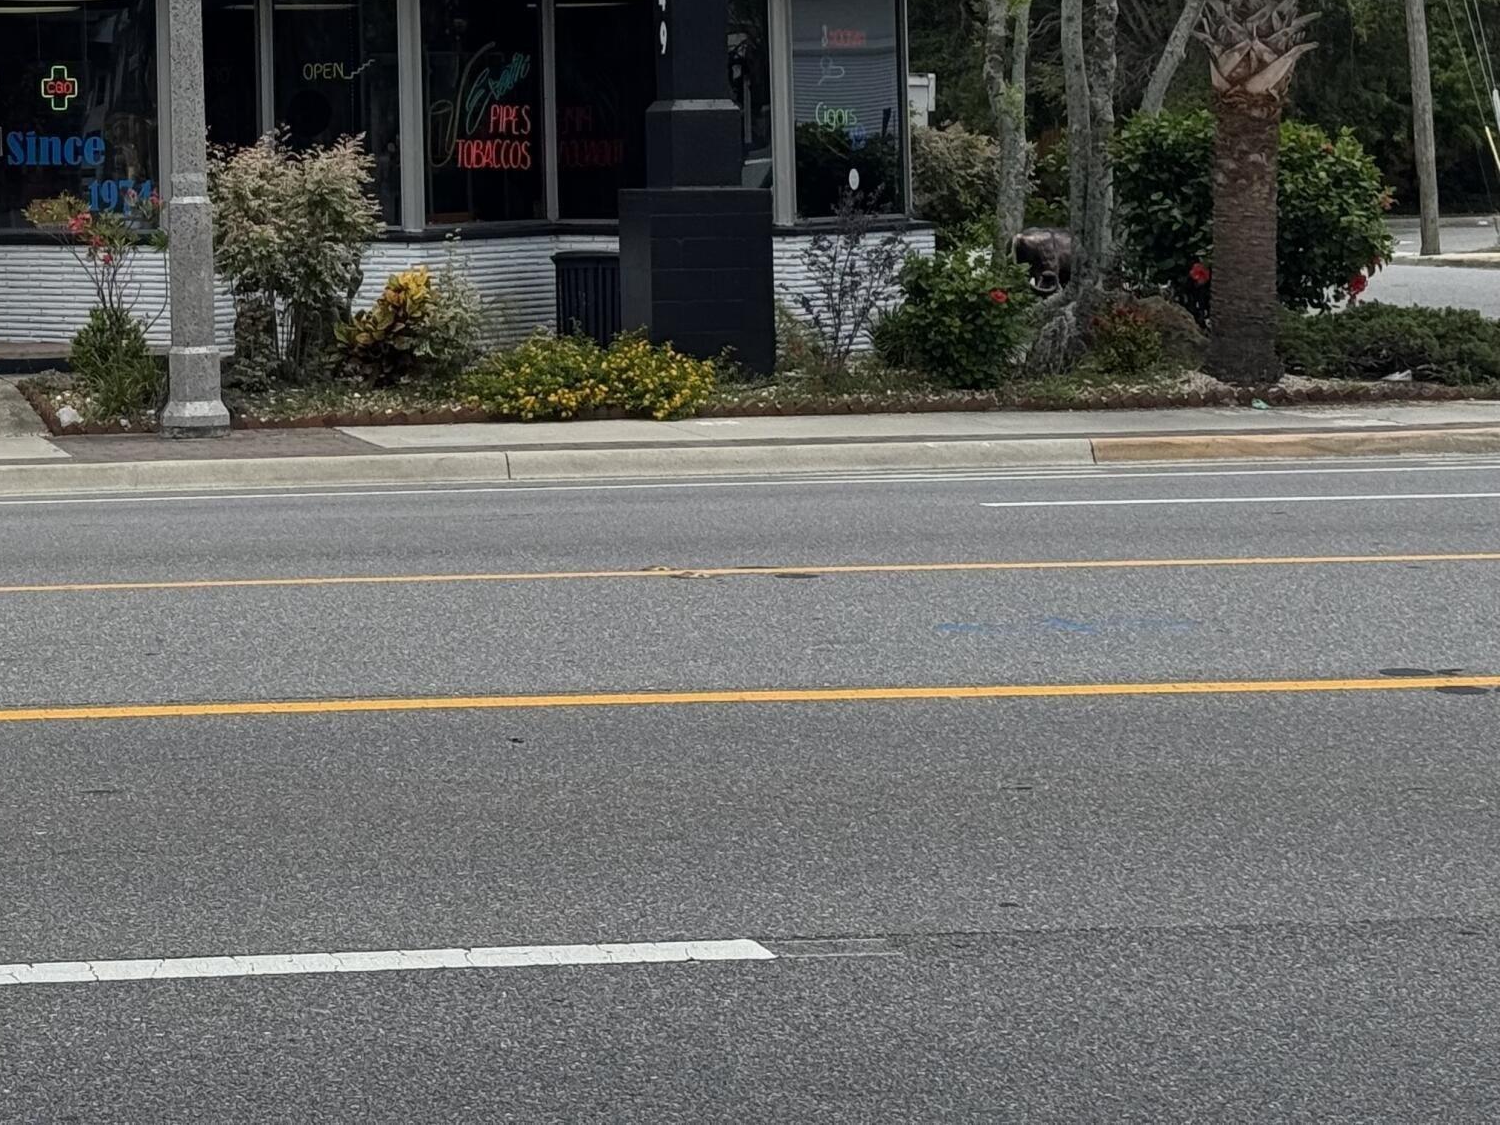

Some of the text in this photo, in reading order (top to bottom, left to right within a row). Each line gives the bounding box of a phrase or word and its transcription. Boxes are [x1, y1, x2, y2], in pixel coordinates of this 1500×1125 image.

[302, 62, 346, 81] OPEN
[46, 81, 73, 94] CBD
[489, 104, 531, 135] PIPES
[815, 101, 858, 132] Cigars
[6, 130, 106, 166] Since
[455, 138, 532, 170] TOBACCOS
